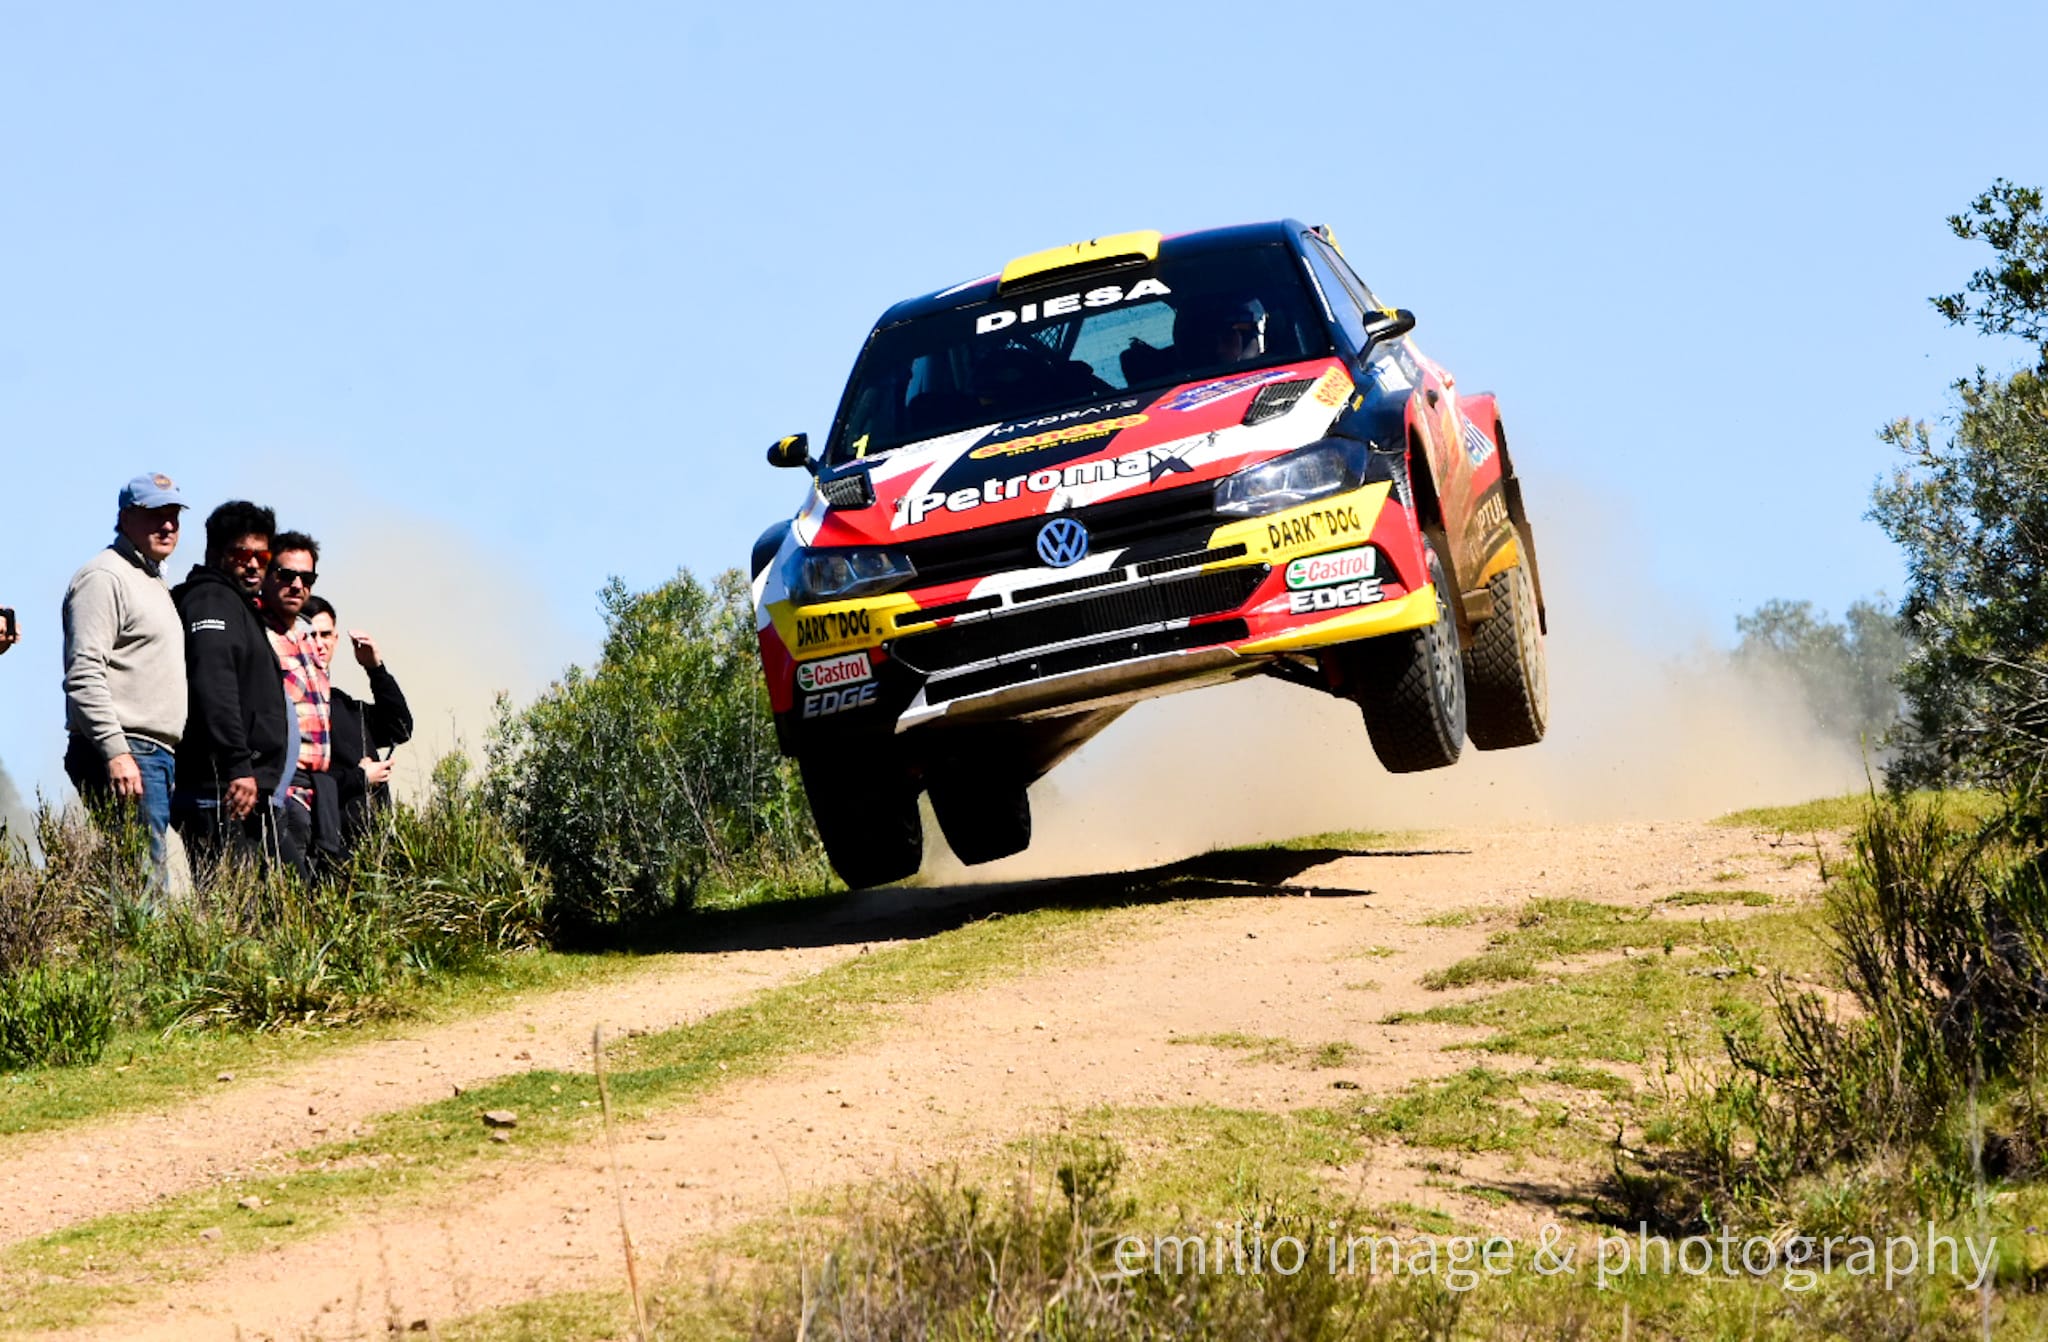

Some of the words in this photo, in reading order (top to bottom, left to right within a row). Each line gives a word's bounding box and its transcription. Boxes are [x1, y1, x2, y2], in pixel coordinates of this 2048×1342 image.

[975, 277, 1172, 335] DIESA
[852, 434, 869, 459] 1
[1267, 514, 1317, 550] DARK
[1325, 506, 1361, 537] DOG
[1308, 551, 1370, 582] Castrol
[1289, 577, 1385, 615] EDGE
[796, 615, 830, 648] DARK
[838, 608, 870, 639] DOG
[814, 657, 868, 687] Castrol
[803, 681, 880, 719] EDGE
